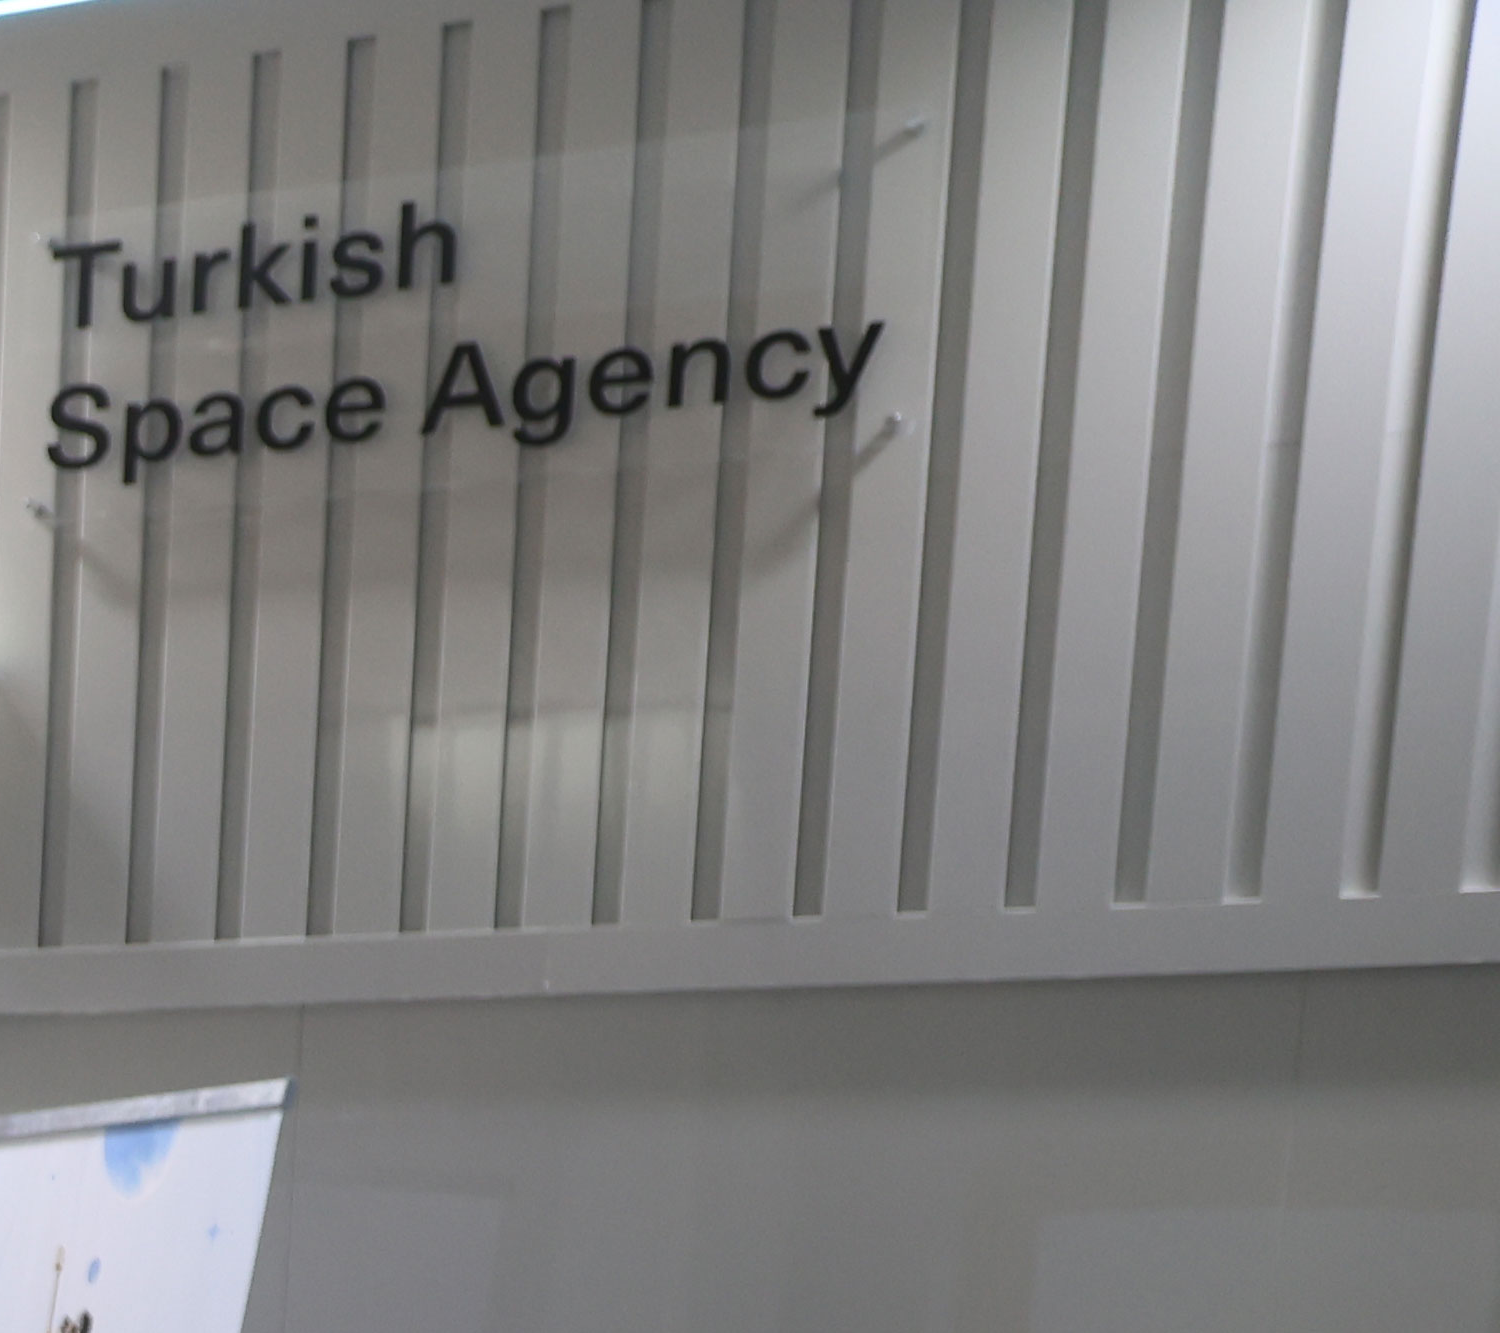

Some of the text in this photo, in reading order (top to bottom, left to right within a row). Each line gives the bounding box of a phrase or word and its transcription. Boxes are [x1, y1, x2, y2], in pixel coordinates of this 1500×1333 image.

[51, 201, 460, 330] Turkish
[45, 316, 887, 488] Space Agency
